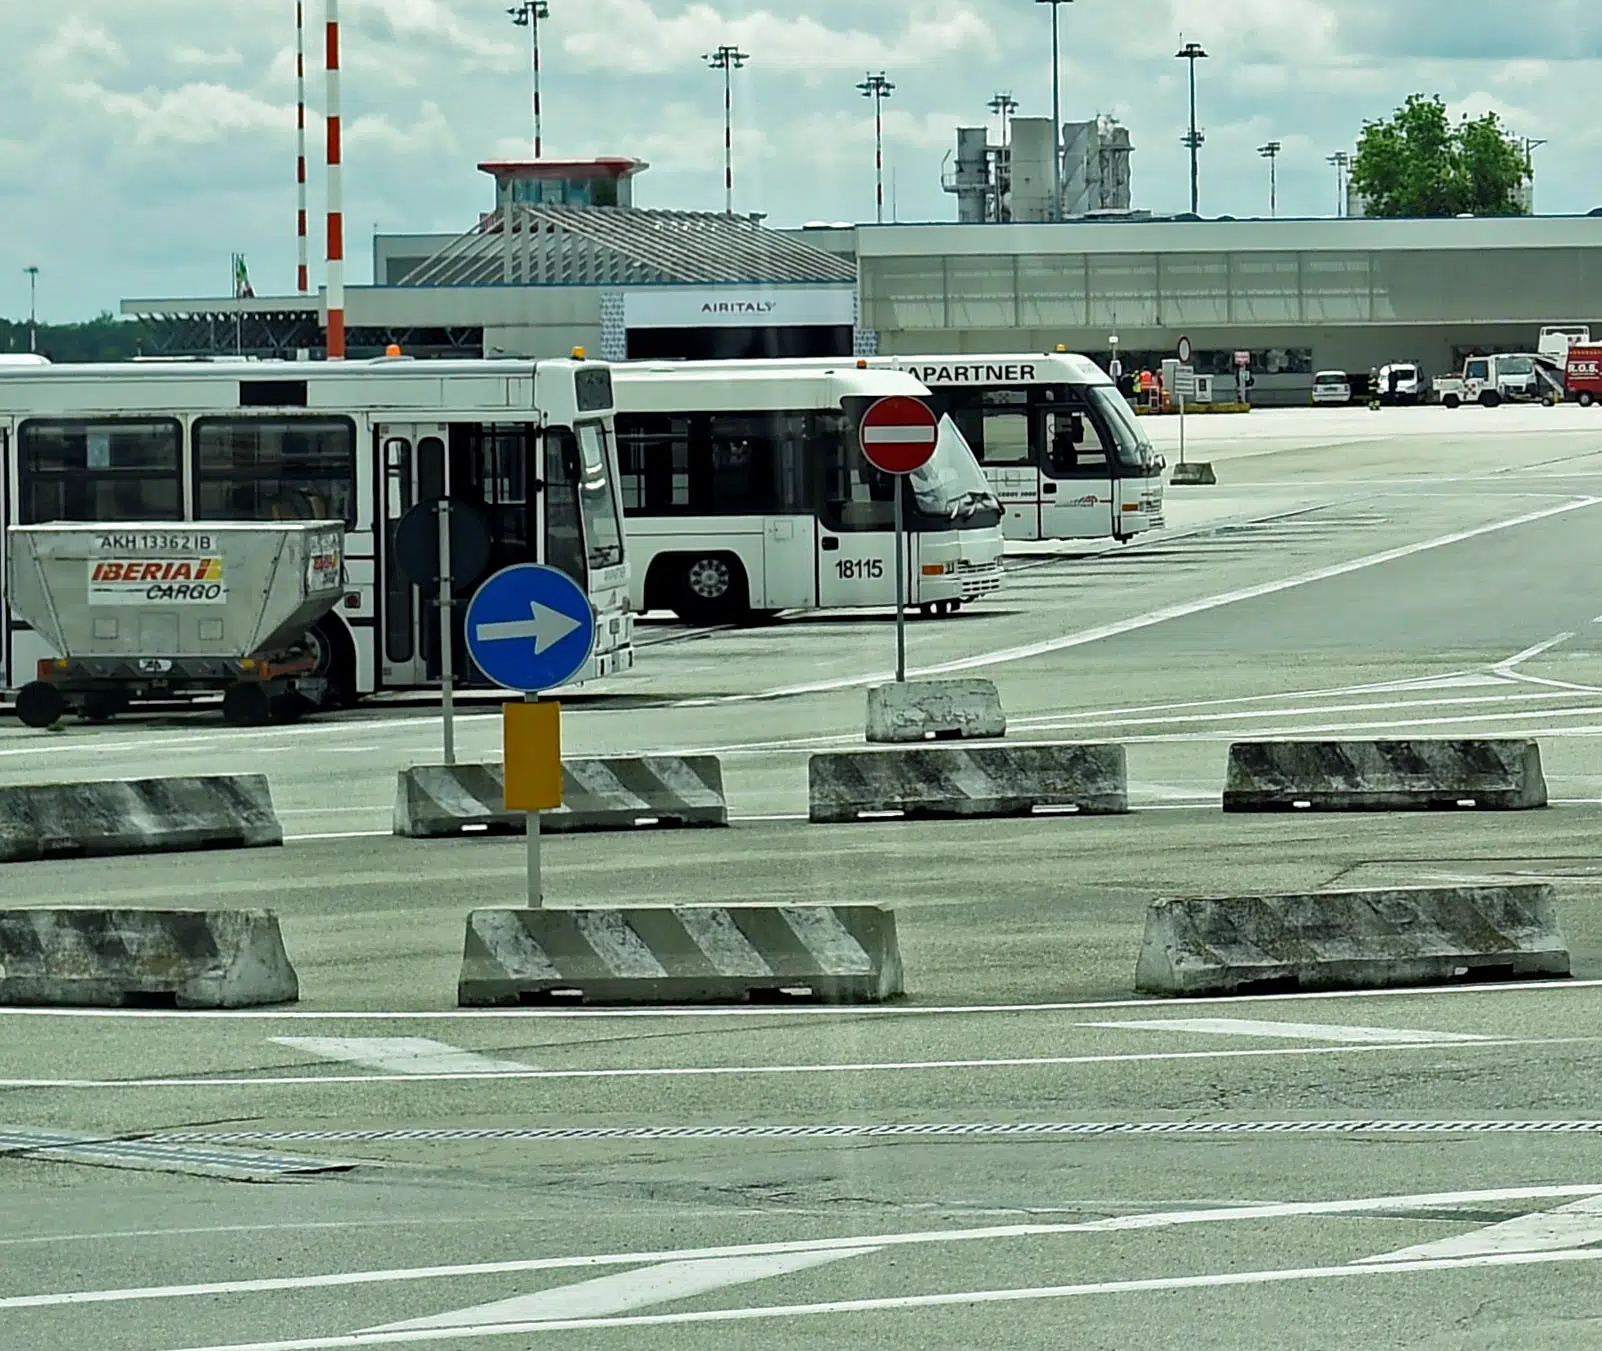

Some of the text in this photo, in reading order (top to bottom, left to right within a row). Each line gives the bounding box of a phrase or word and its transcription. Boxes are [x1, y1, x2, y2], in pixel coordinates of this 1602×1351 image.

[870, 364, 1035, 382] APARTNER
[100, 535, 136, 549] AKH
[92, 562, 192, 581] IBERIA
[835, 559, 883, 579] 18115
[146, 584, 221, 600] CARGO
